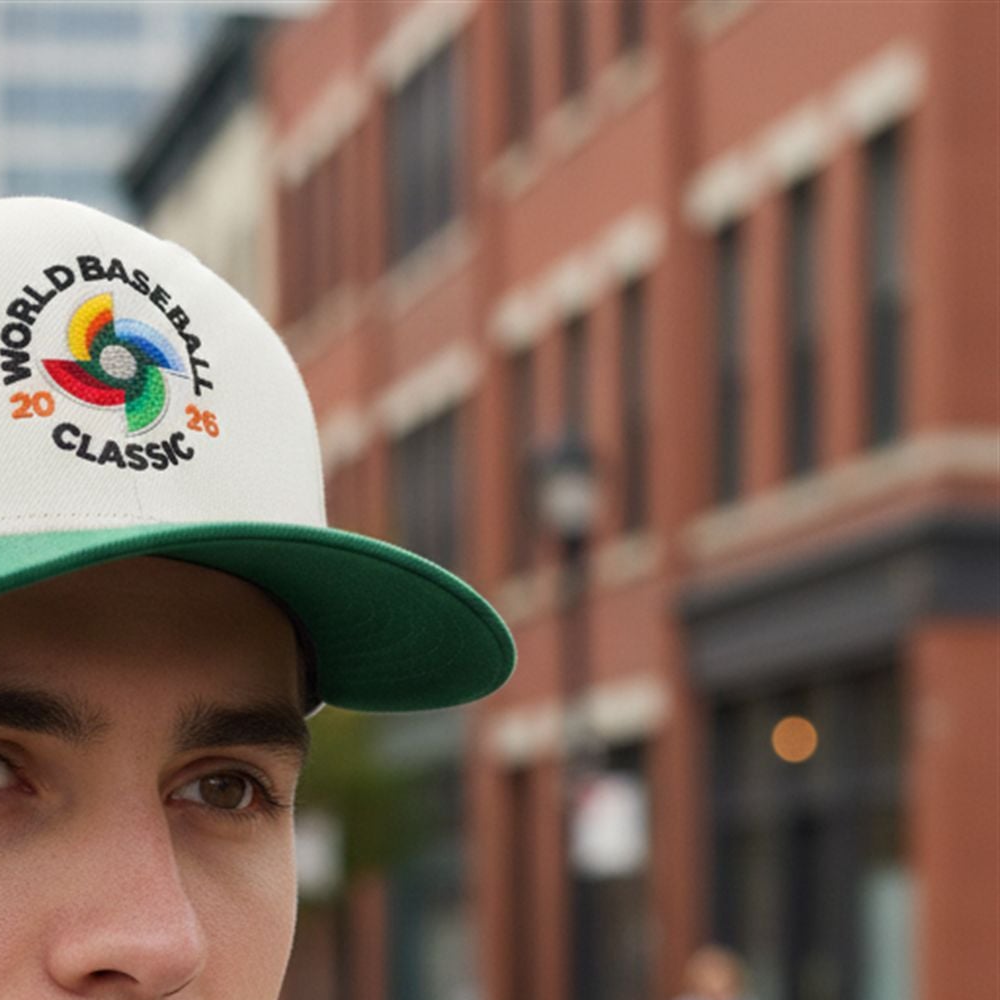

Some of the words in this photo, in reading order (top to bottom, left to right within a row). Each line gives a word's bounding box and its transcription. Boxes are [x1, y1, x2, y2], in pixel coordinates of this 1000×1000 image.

[0, 264, 76, 386] WORLD
[76, 255, 213, 396] BASEBALL
[9, 391, 56, 419] 20
[185, 403, 220, 437] 26
[52, 422, 194, 470] CLASSIC
